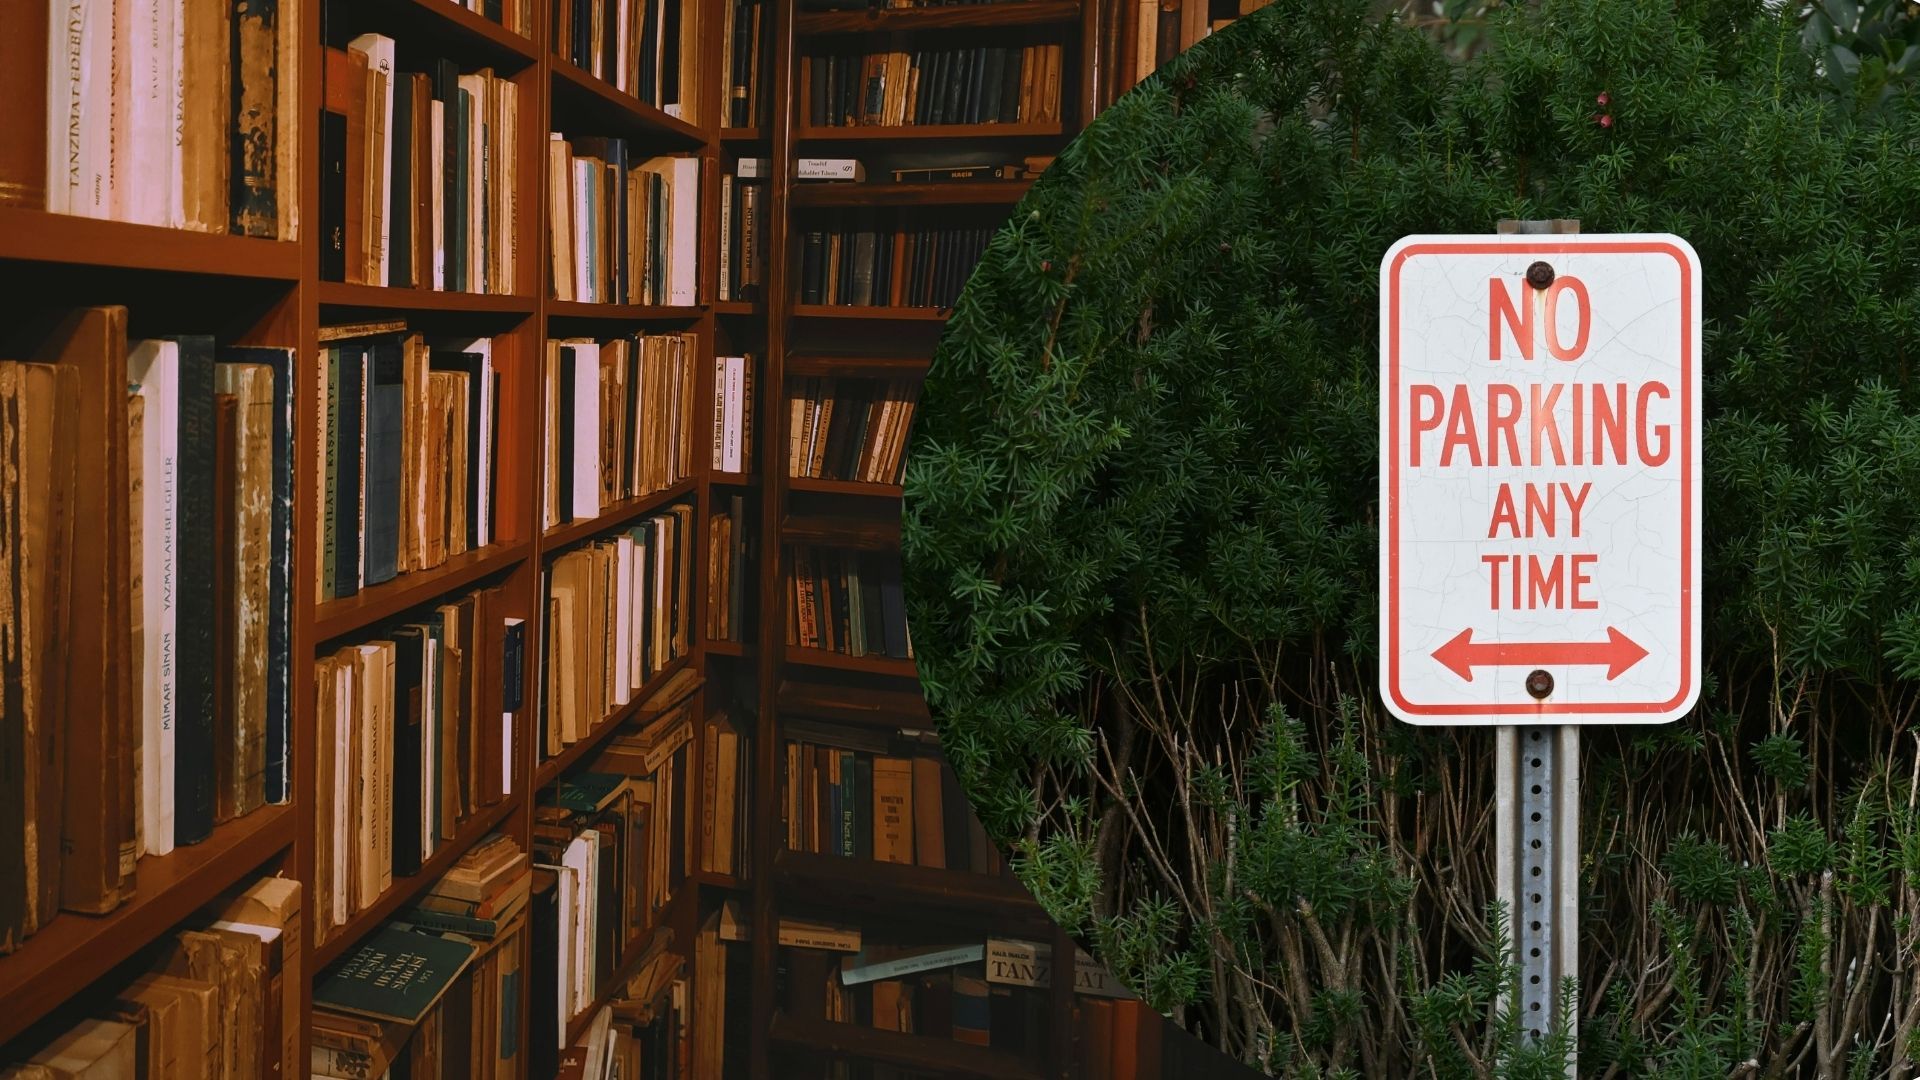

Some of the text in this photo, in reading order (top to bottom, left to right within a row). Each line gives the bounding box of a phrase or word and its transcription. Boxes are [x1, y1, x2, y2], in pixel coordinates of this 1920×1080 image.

[1489, 276, 1591, 362] NO
[1409, 380, 1671, 468] PARKING
[1487, 482, 1593, 539] ANY
[1481, 554, 1599, 610] TIME
[373, 952, 414, 987] HEYKEL
